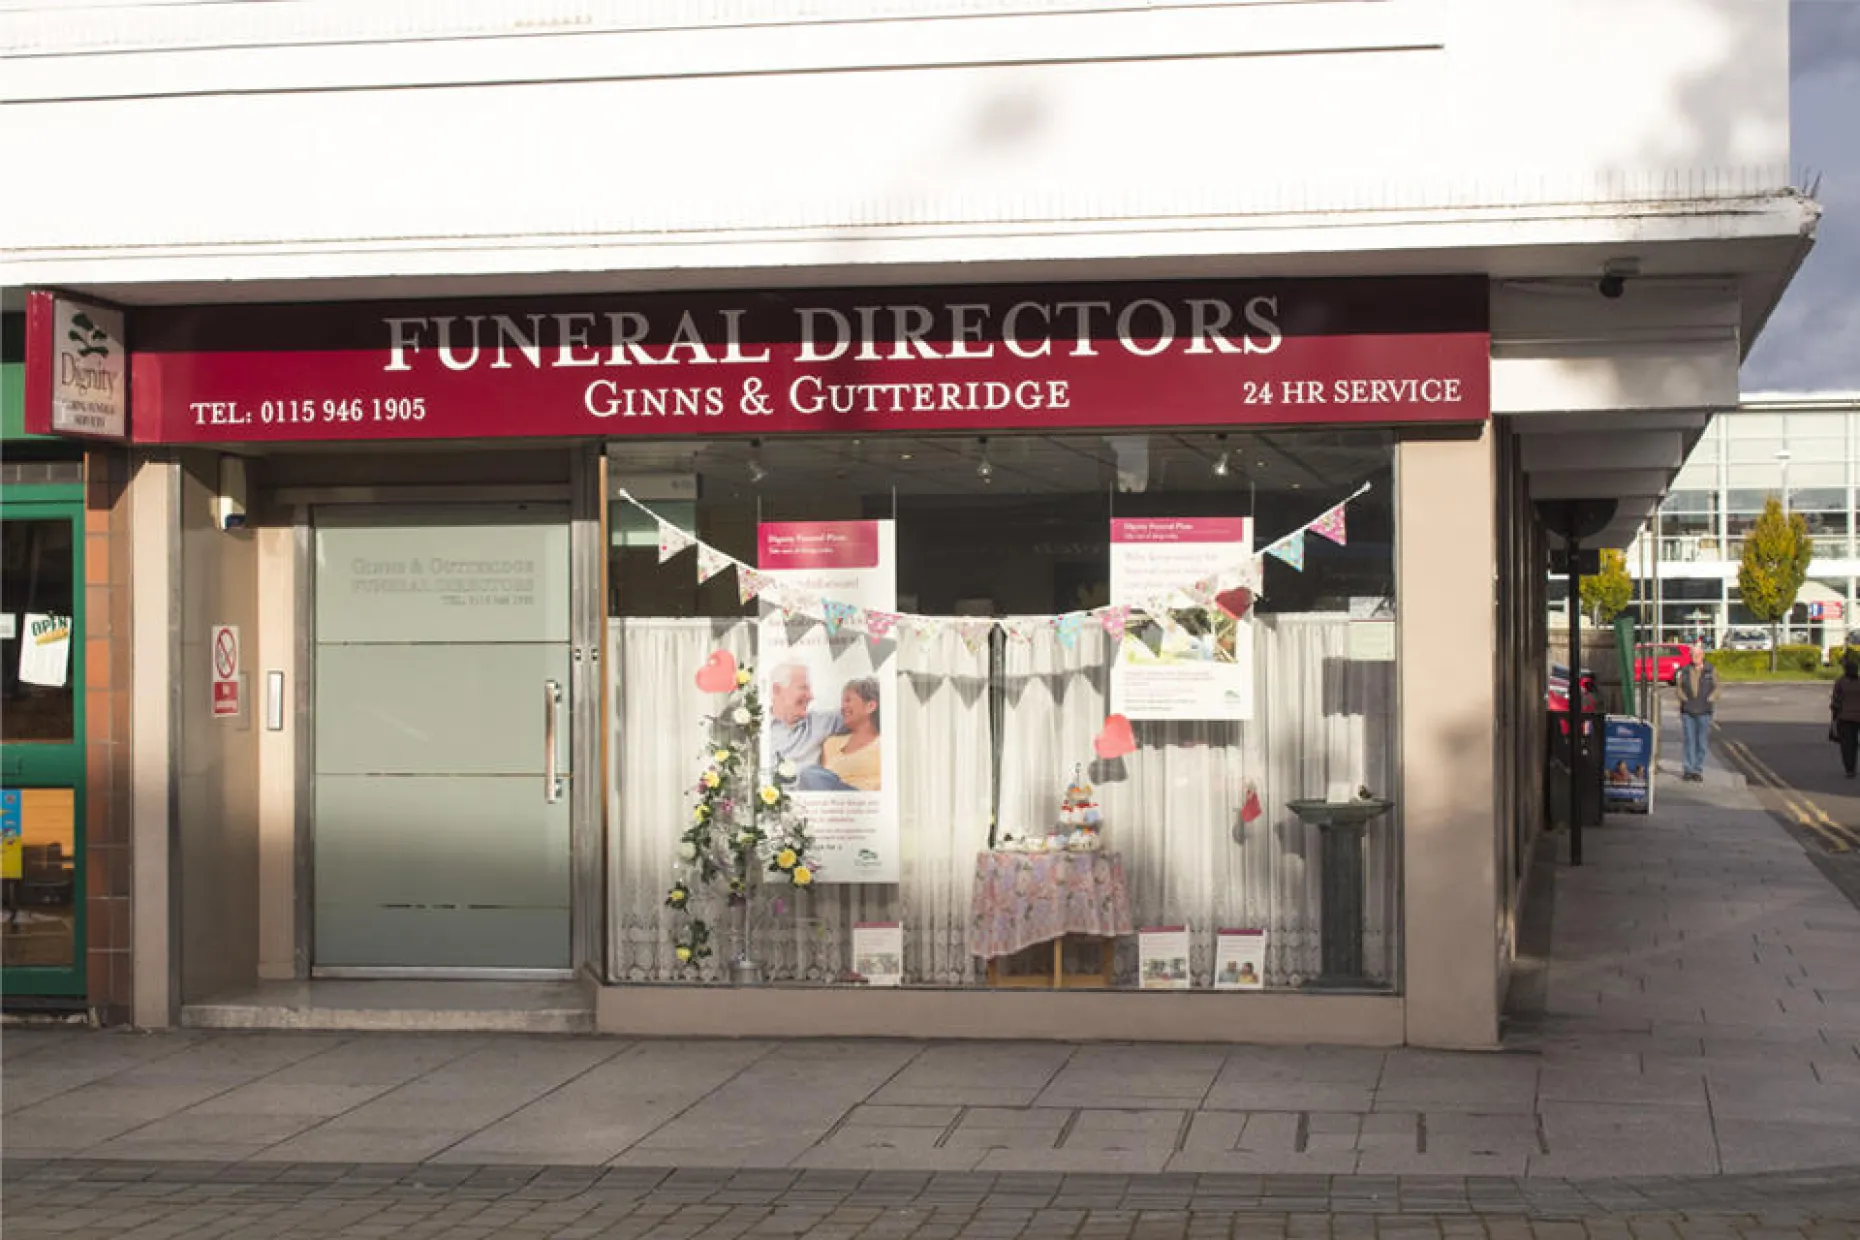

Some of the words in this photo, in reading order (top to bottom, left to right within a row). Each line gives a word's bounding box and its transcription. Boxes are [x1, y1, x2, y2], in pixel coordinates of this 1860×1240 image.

[384, 310, 770, 371] FUNERAL
[794, 297, 1283, 362] DIRECTORS
[61, 351, 118, 400] Dignity
[584, 379, 724, 417] GINNS
[740, 376, 774, 416] &
[790, 375, 1070, 414] GUTTERIDGE
[1243, 380, 1274, 405] 24
[1281, 380, 1327, 404] HR
[1334, 378, 1462, 403] SERVICE
[189, 402, 252, 425] TEL:
[260, 400, 315, 423] 0115
[322, 399, 364, 422] 946
[373, 398, 426, 421] 1905
